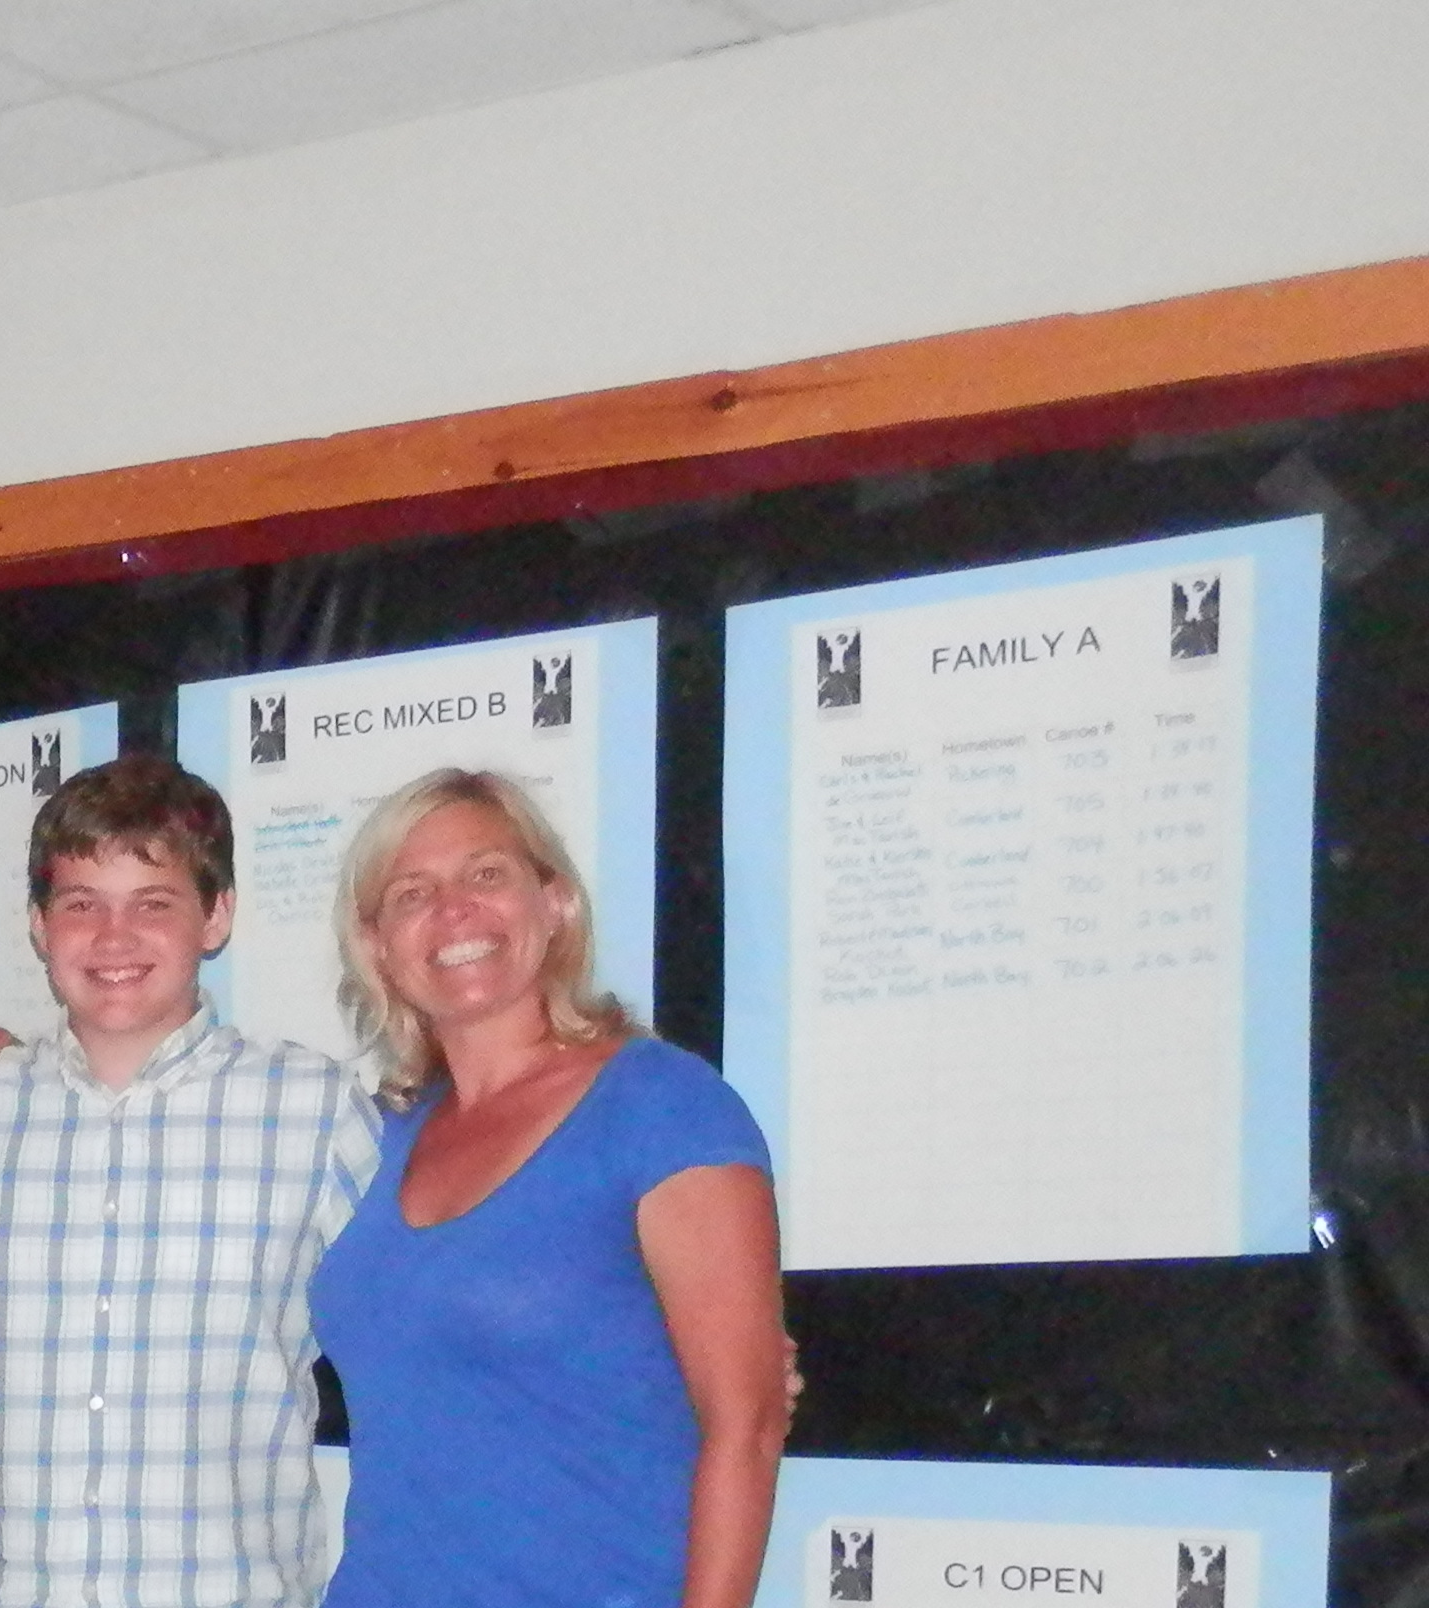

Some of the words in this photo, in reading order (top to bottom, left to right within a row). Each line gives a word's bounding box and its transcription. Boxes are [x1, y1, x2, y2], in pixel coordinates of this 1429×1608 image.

[931, 630, 1063, 676] FAMILY
[1076, 627, 1102, 655] A
[313, 708, 373, 740] REC
[384, 695, 478, 731] MIXED
[488, 691, 507, 717] B
[841, 749, 908, 768] Name(s)
[942, 733, 1027, 756] Hometown
[1045, 723, 1099, 744] Canoe
[1153, 711, 1196, 728] Time
[944, 1561, 986, 1590] C1
[1000, 1565, 1106, 1596] OPEN
